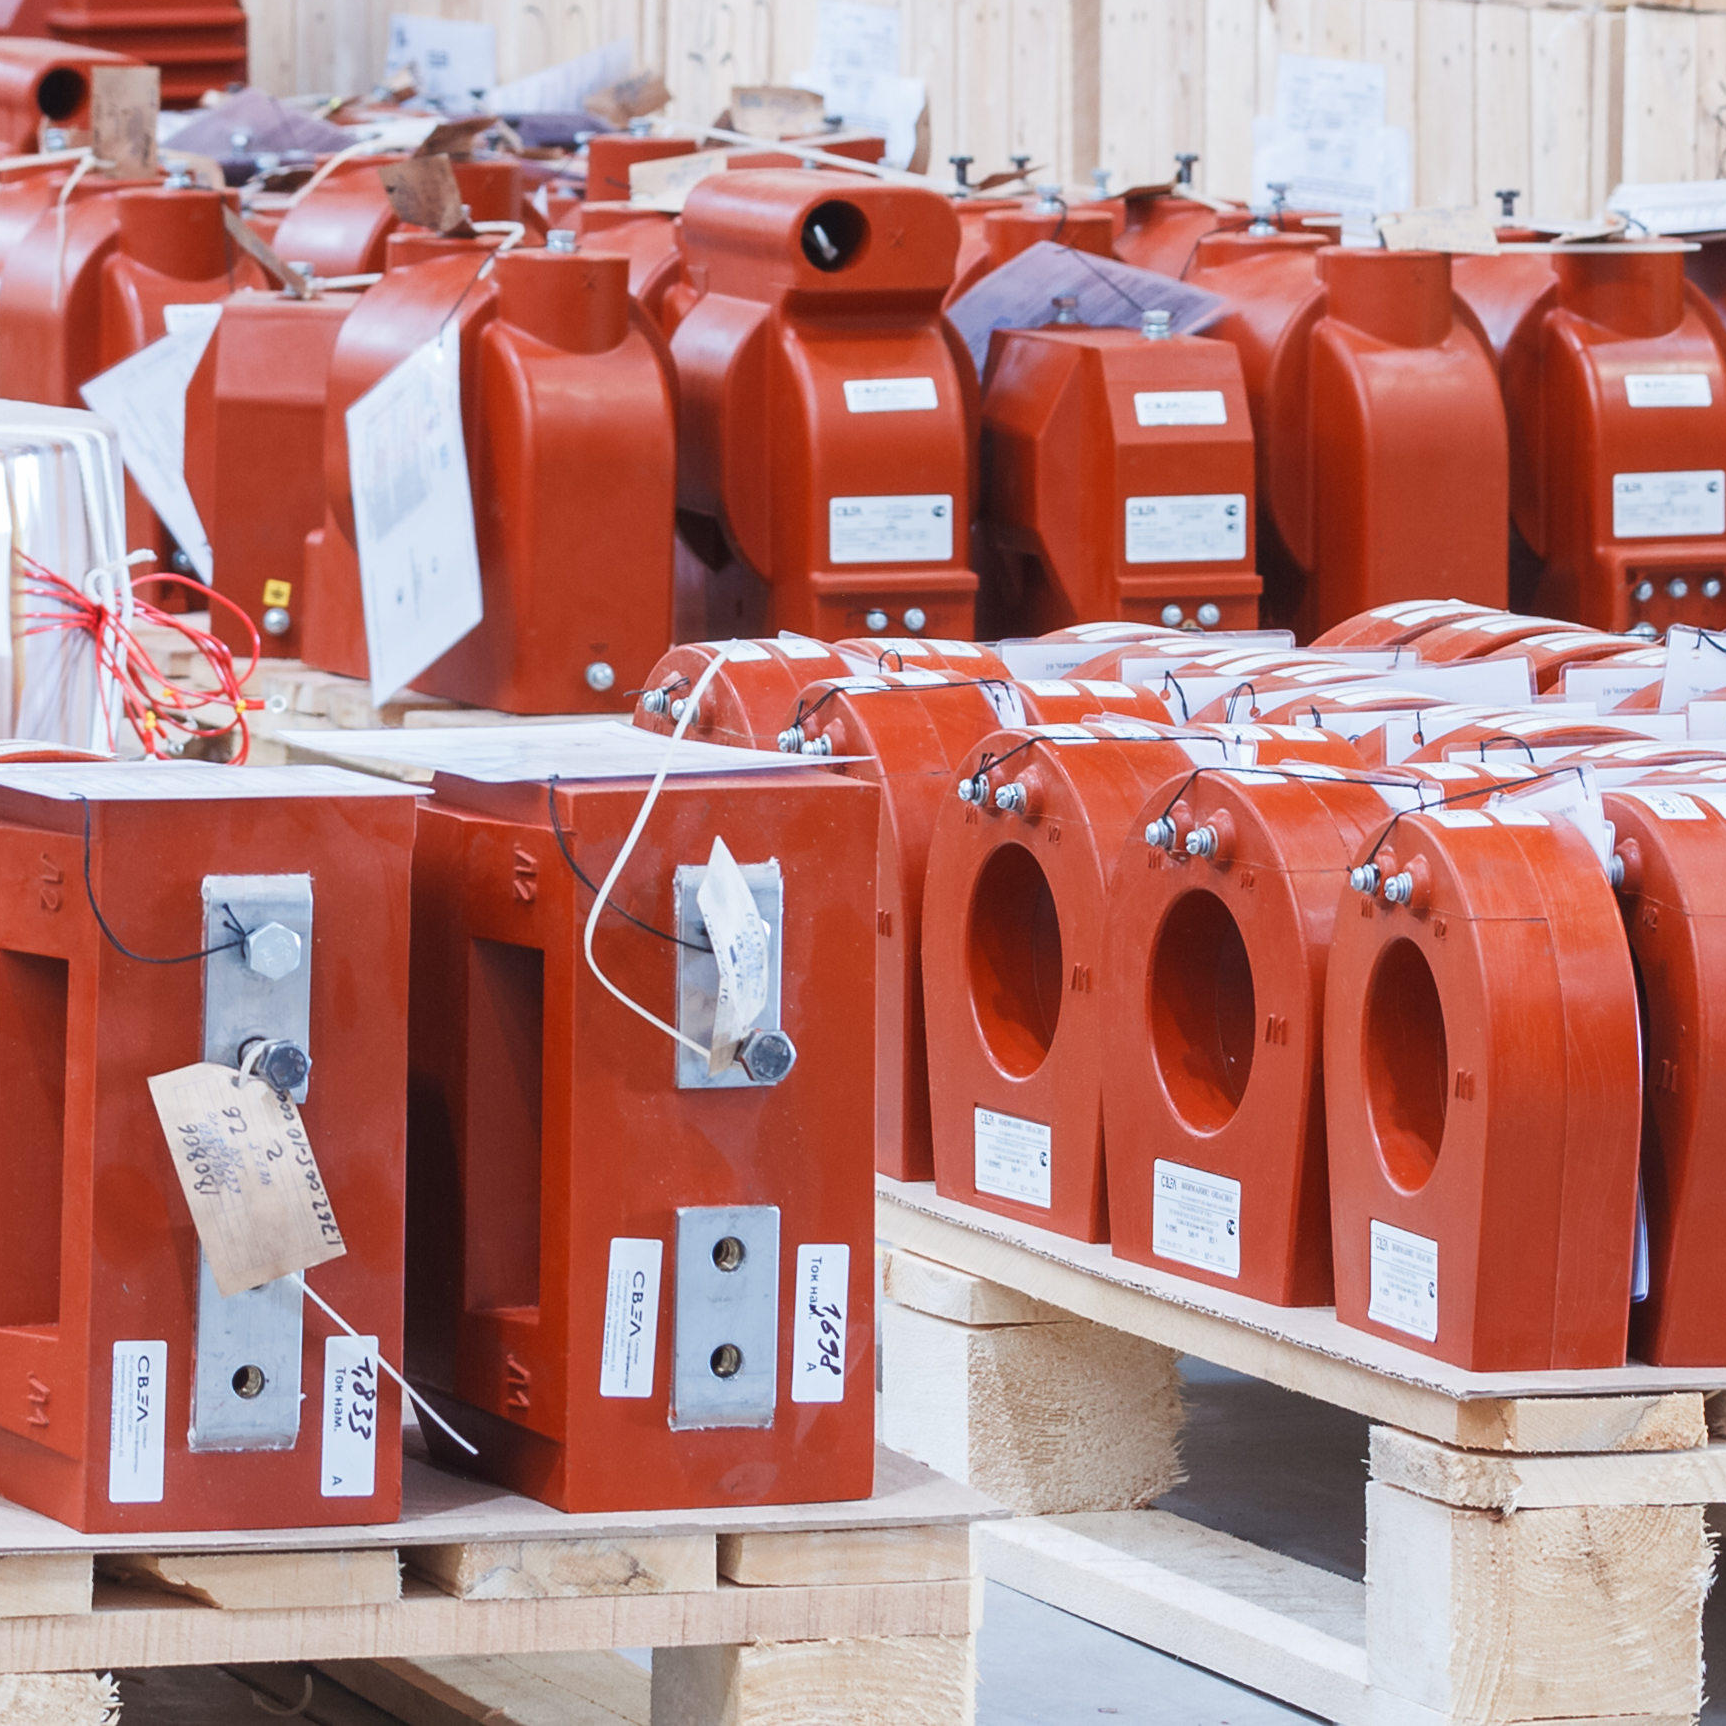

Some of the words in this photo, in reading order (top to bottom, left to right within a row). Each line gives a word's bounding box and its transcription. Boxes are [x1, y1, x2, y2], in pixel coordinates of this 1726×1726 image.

[811, 1257, 822, 1281] Ток
[335, 1367, 346, 1393] Ток
[506, 1354, 531, 1409] Л1
[26, 1371, 51, 1427] Л1
[333, 1398, 343, 1432] нам.
